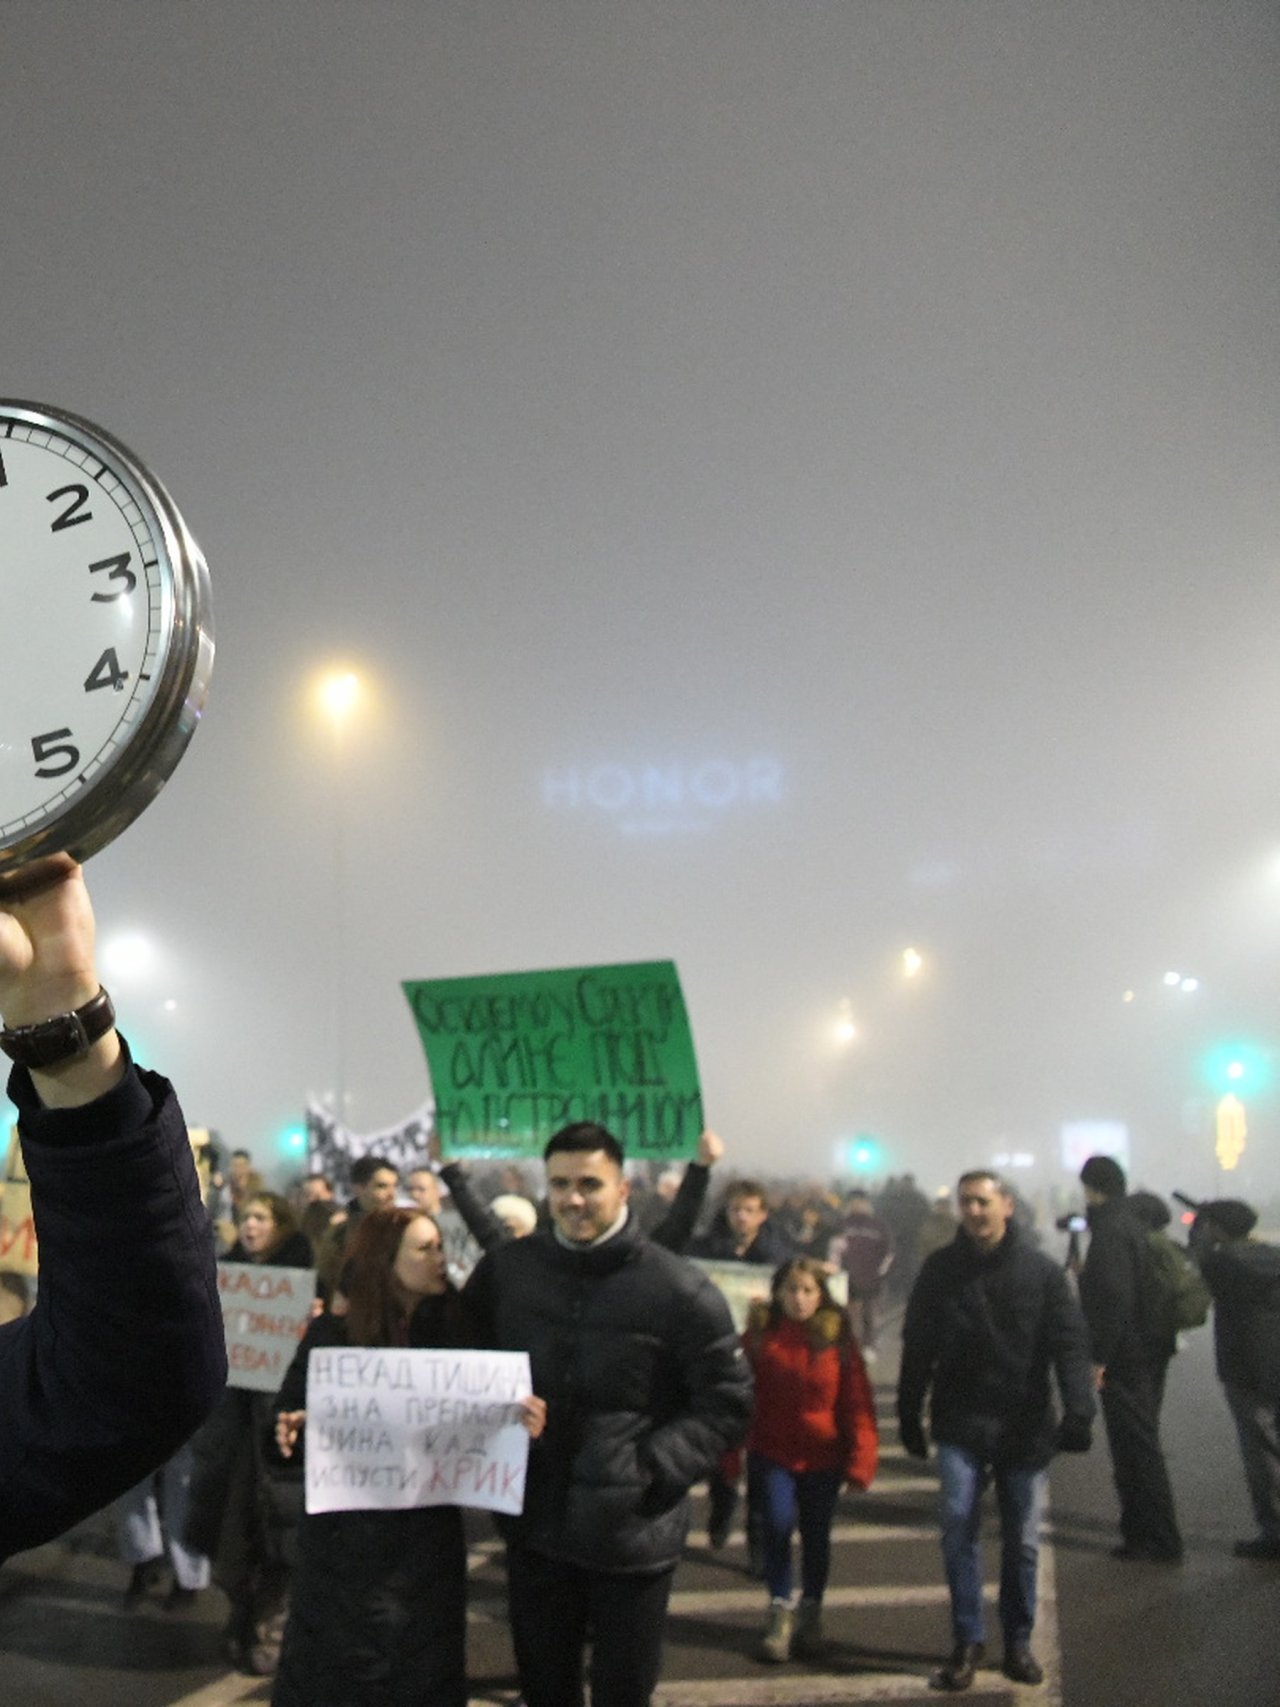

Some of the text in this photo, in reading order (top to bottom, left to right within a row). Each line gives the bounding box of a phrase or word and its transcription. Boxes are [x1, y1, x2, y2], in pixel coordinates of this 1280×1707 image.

[46, 484, 93, 532] 2
[88, 552, 137, 602] 3
[84, 647, 130, 693] 4
[31, 728, 80, 778] 5
[540, 757, 784, 809] HONOR
[314, 1354, 415, 1390] НЕКАД
